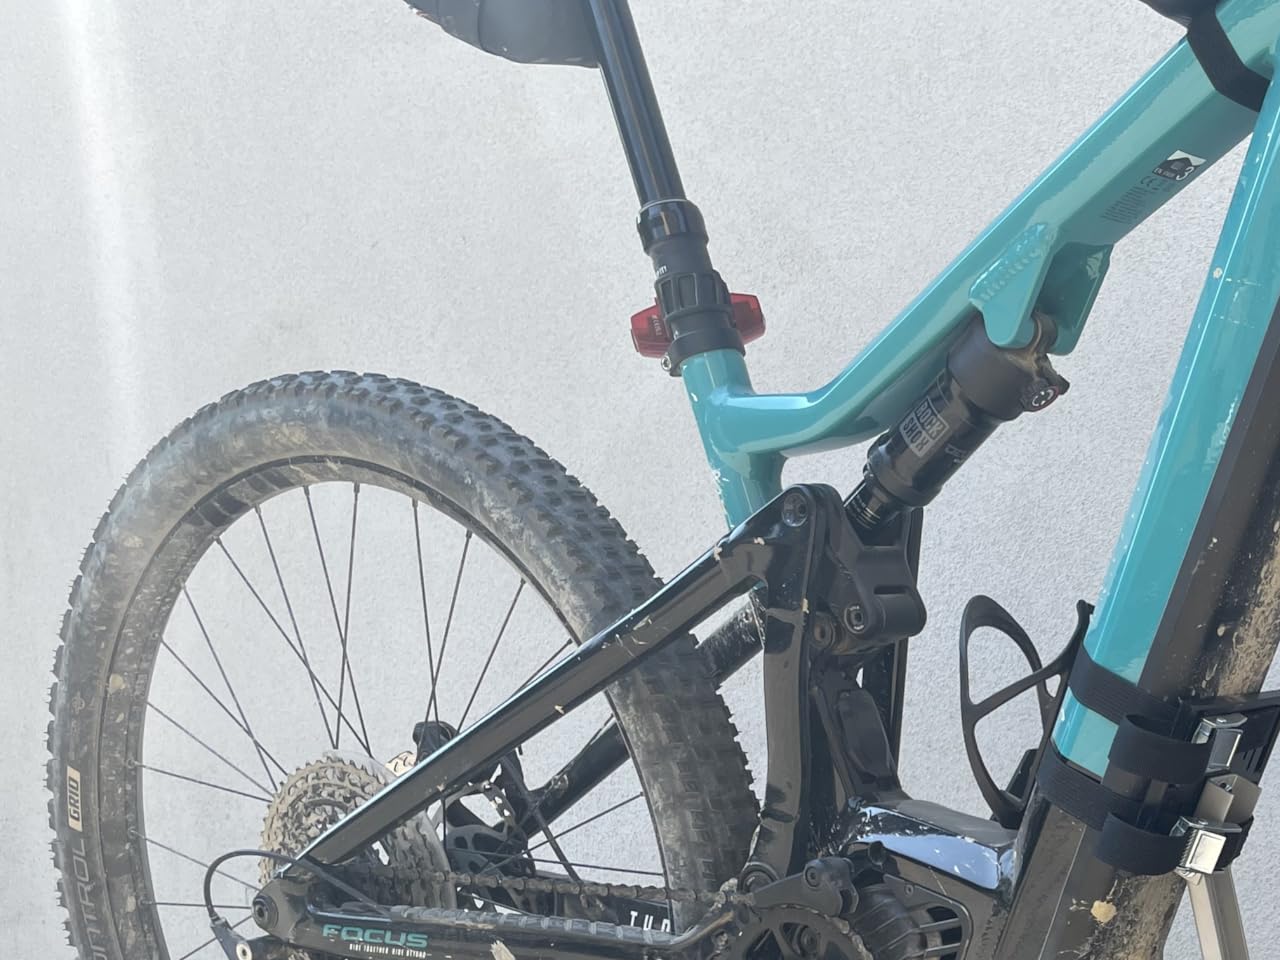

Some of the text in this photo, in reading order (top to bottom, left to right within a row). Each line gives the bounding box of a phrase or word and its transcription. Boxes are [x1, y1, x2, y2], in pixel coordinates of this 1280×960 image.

[903, 416, 931, 452] SHOX
[915, 401, 944, 438] ROCK
[67, 776, 81, 822] GRID
[322, 924, 428, 948] FOCUS
